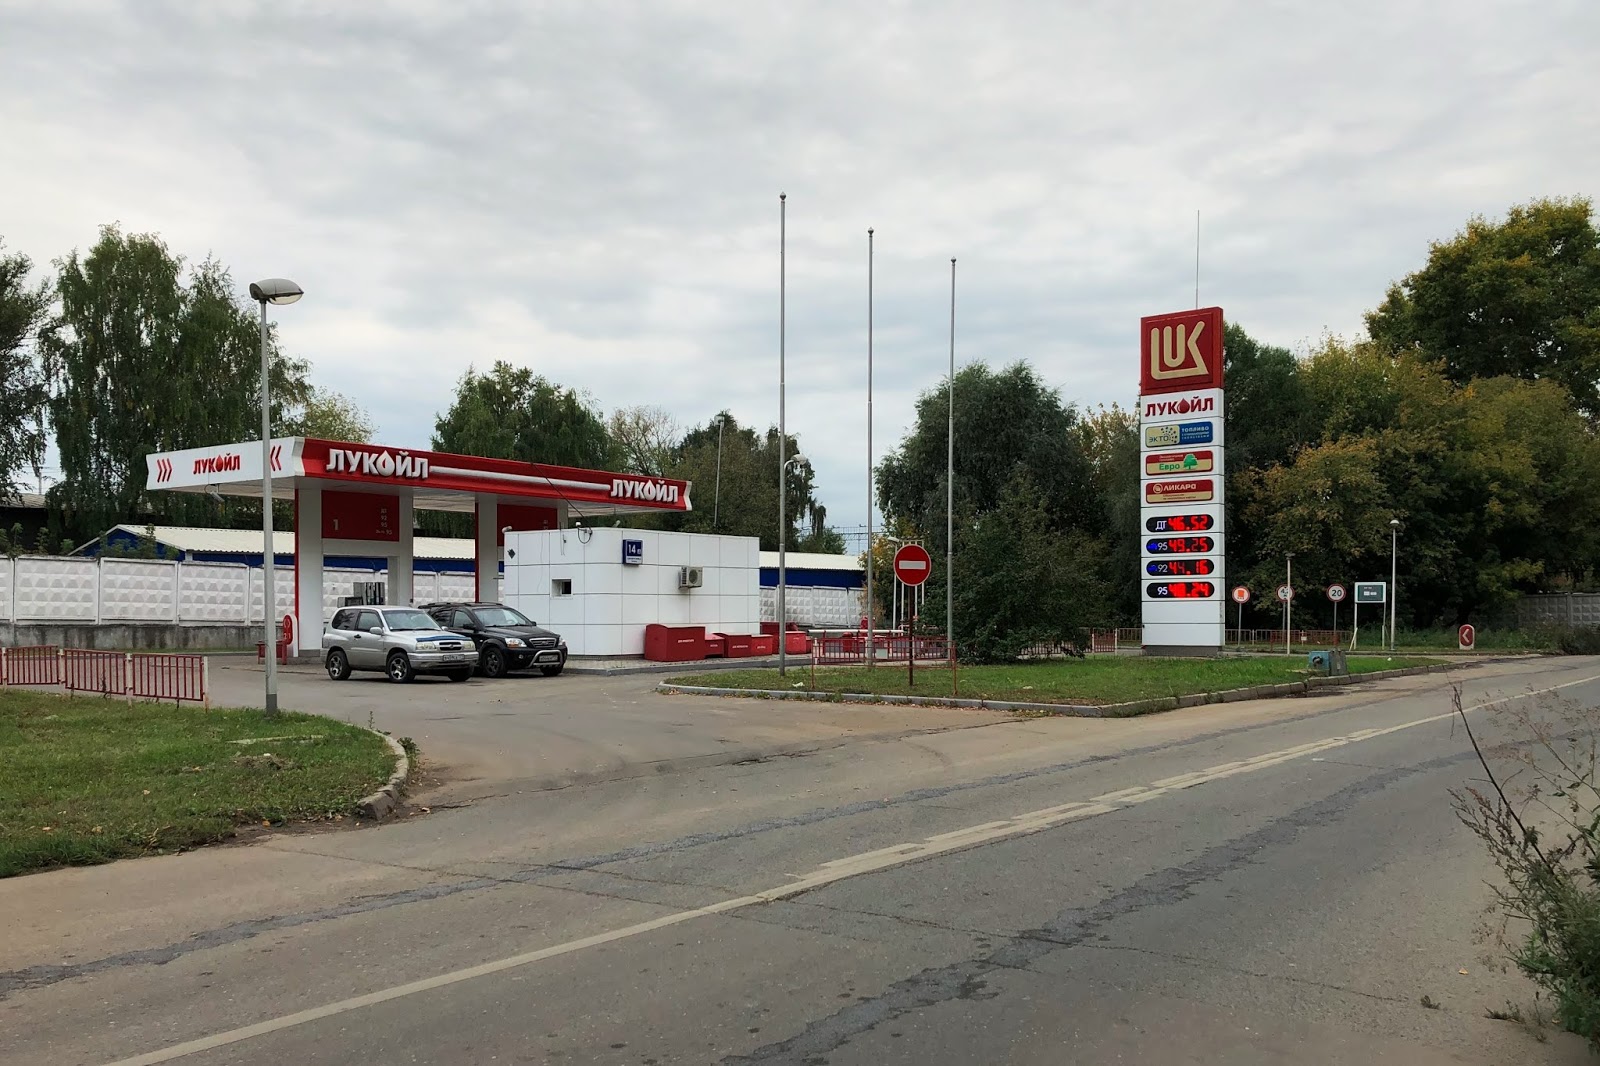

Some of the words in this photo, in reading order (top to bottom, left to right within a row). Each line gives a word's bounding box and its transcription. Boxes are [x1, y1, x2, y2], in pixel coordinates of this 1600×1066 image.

[1145, 395, 1214, 417] ЛУКОЙЛ
[1149, 435, 1169, 443] ЭКТО
[192, 453, 241, 475] ЛУКОЙЛ
[326, 448, 429, 478] ЛУКОЙЛ
[1159, 463, 1180, 471] Евро
[610, 478, 679, 503] ЛУКОЙЛ
[333, 518, 339, 531] 1
[1155, 520, 1167, 531] ДТ
[1168, 515, 1208, 531] 46.52
[628, 544, 636, 554] 14
[1157, 541, 1168, 551] 95
[1168, 537, 1208, 552] 49.25
[1157, 563, 1168, 573] 92
[1169, 560, 1208, 575] 44.16
[1157, 586, 1168, 596] 95
[1331, 589, 1342, 597] 20
